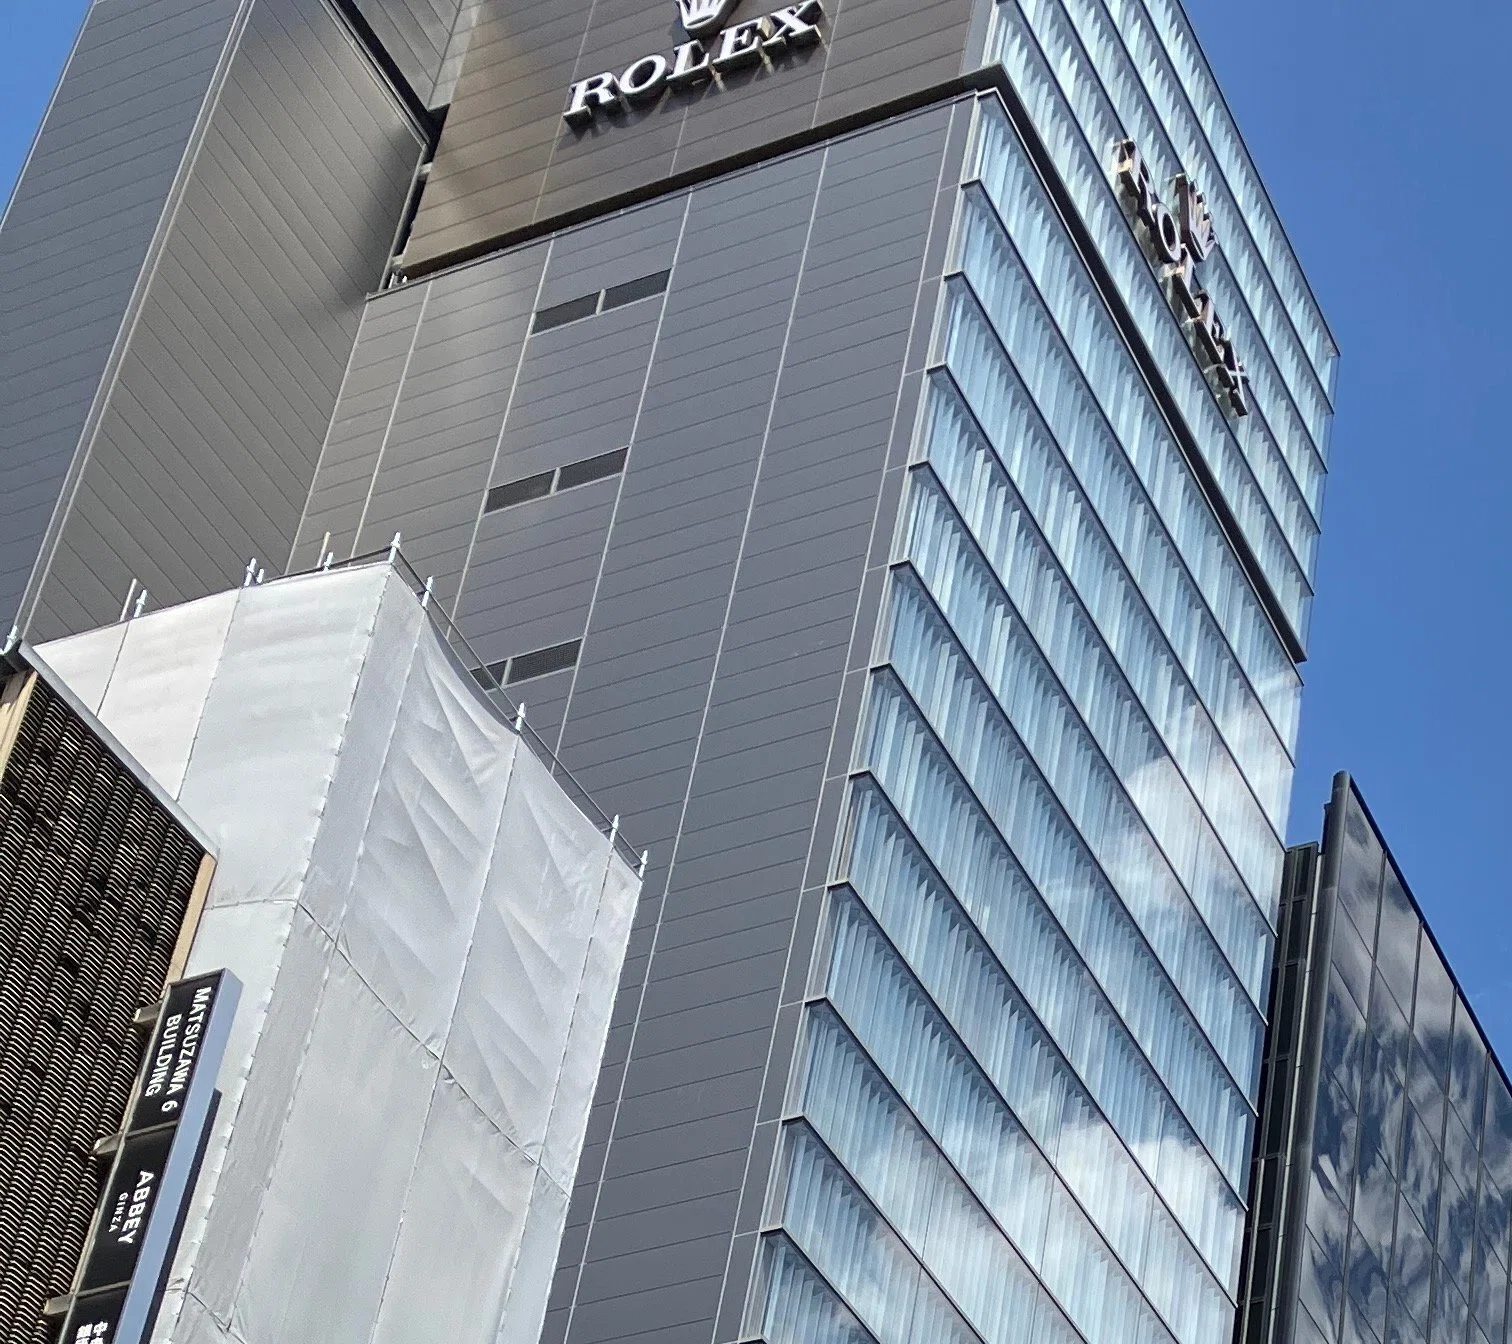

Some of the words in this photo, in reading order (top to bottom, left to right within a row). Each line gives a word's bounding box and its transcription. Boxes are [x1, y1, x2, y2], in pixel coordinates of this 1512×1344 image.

[563, 0, 822, 120] ROLEX
[145, 1013, 182, 1097] BUILDING
[168, 986, 212, 1095] MATSUZAWA
[161, 1099, 178, 1113] 6
[107, 1191, 129, 1234] GINZA
[117, 1169, 154, 1244] ABBEY
